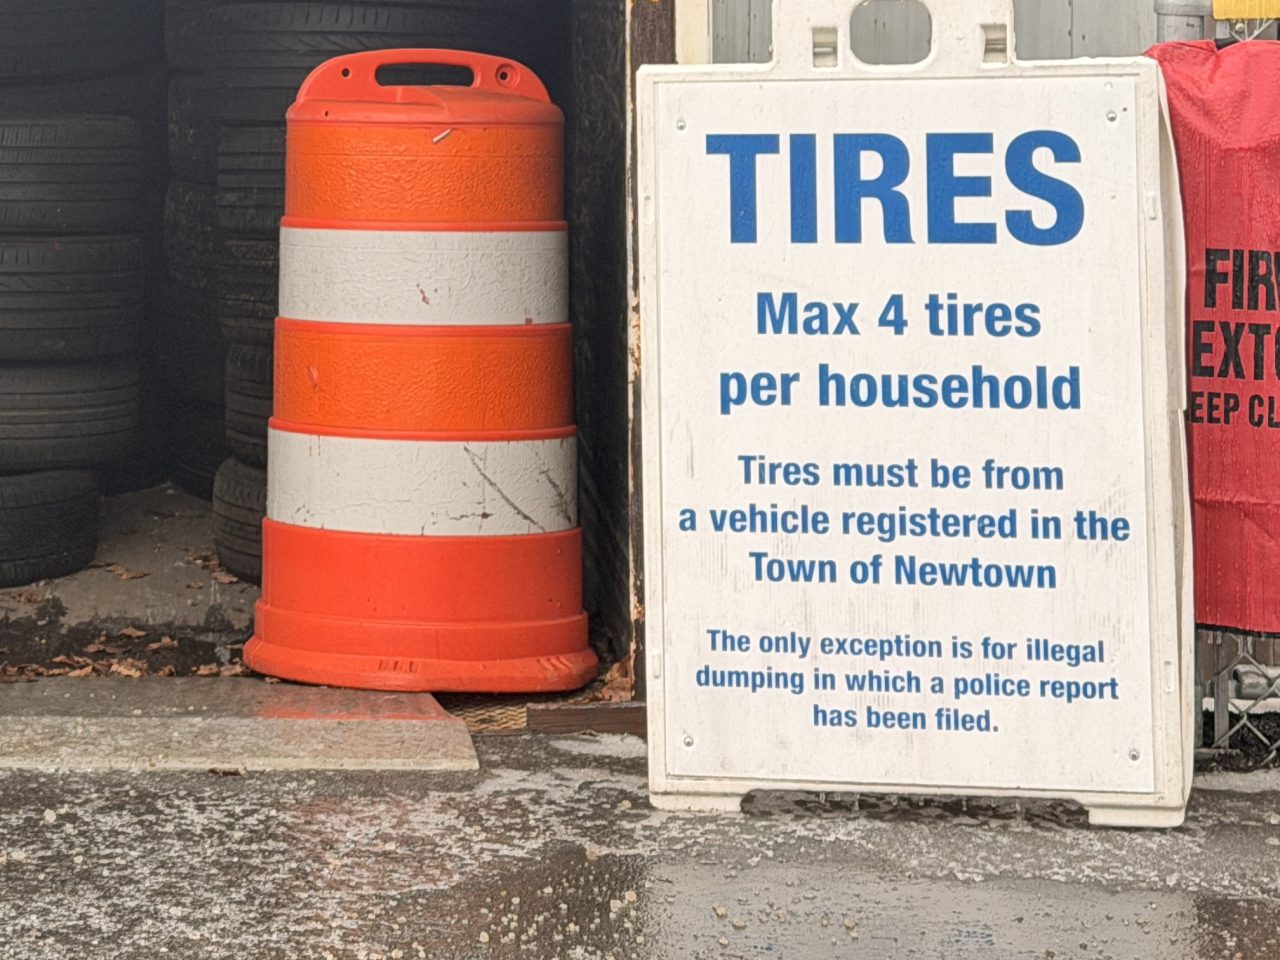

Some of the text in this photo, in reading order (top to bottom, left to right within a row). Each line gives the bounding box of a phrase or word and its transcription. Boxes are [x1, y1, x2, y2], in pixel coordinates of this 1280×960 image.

[706, 130, 1084, 246] TIRES
[757, 293, 1040, 337] Max 4 tires
[720, 364, 1080, 415] per household
[1186, 391, 1239, 425] EEP
[738, 456, 1063, 489] Tires must be from
[679, 504, 1129, 542] a vehicle registered in the
[749, 552, 1056, 588] Town of Newtown
[707, 630, 1104, 667] The only exception is for illegal
[696, 665, 1118, 703] dumping in which a police report
[814, 704, 997, 731] has been filed.
